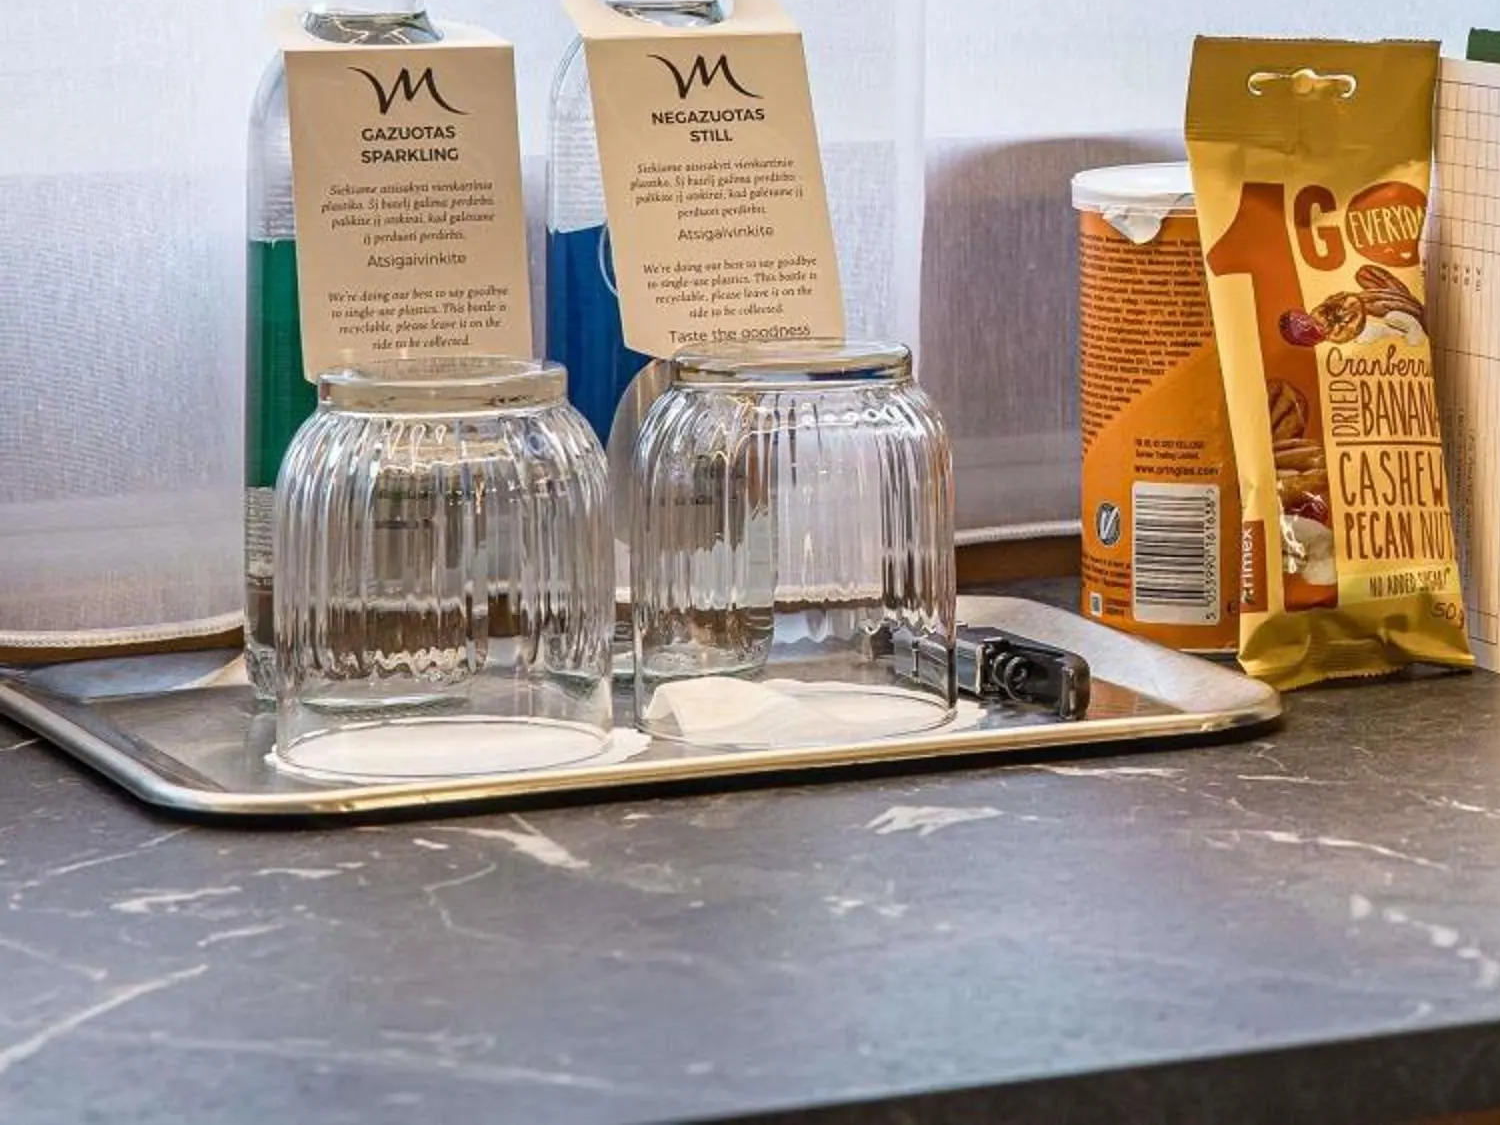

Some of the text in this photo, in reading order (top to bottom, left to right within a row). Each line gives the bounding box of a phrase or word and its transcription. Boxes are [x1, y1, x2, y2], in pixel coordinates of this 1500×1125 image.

[651, 107, 765, 126] NEGAZUOTAS
[361, 126, 456, 143] GAZUOTAS
[689, 130, 733, 144] STILL
[361, 148, 459, 165] SPARKLING
[643, 256, 817, 275] We're doing our best to say goodbye
[647, 279, 657, 289] to
[754, 272, 776, 284] This
[778, 271, 807, 283] bottle
[809, 271, 817, 281] is
[328, 284, 508, 304] We're doing our best to say goodbye
[711, 291, 741, 304] please
[744, 288, 769, 300] leave
[772, 287, 780, 299] it
[782, 287, 794, 297] on
[797, 285, 813, 297] the
[331, 308, 342, 318] to
[442, 301, 464, 315] This
[467, 300, 496, 313] bottle
[689, 307, 708, 319] side
[711, 307, 722, 317] to
[723, 305, 736, 317] be
[395, 319, 429, 334] please
[430, 317, 456, 330] leave
[459, 317, 467, 329] it
[469, 318, 482, 329] on
[484, 315, 501, 328] the
[668, 323, 812, 345] Taste the goodness
[372, 337, 393, 351] side
[395, 337, 406, 348] to
[408, 335, 420, 348] be
[1328, 380, 1360, 437] DRIED
[1345, 511, 1415, 562] PECAN
